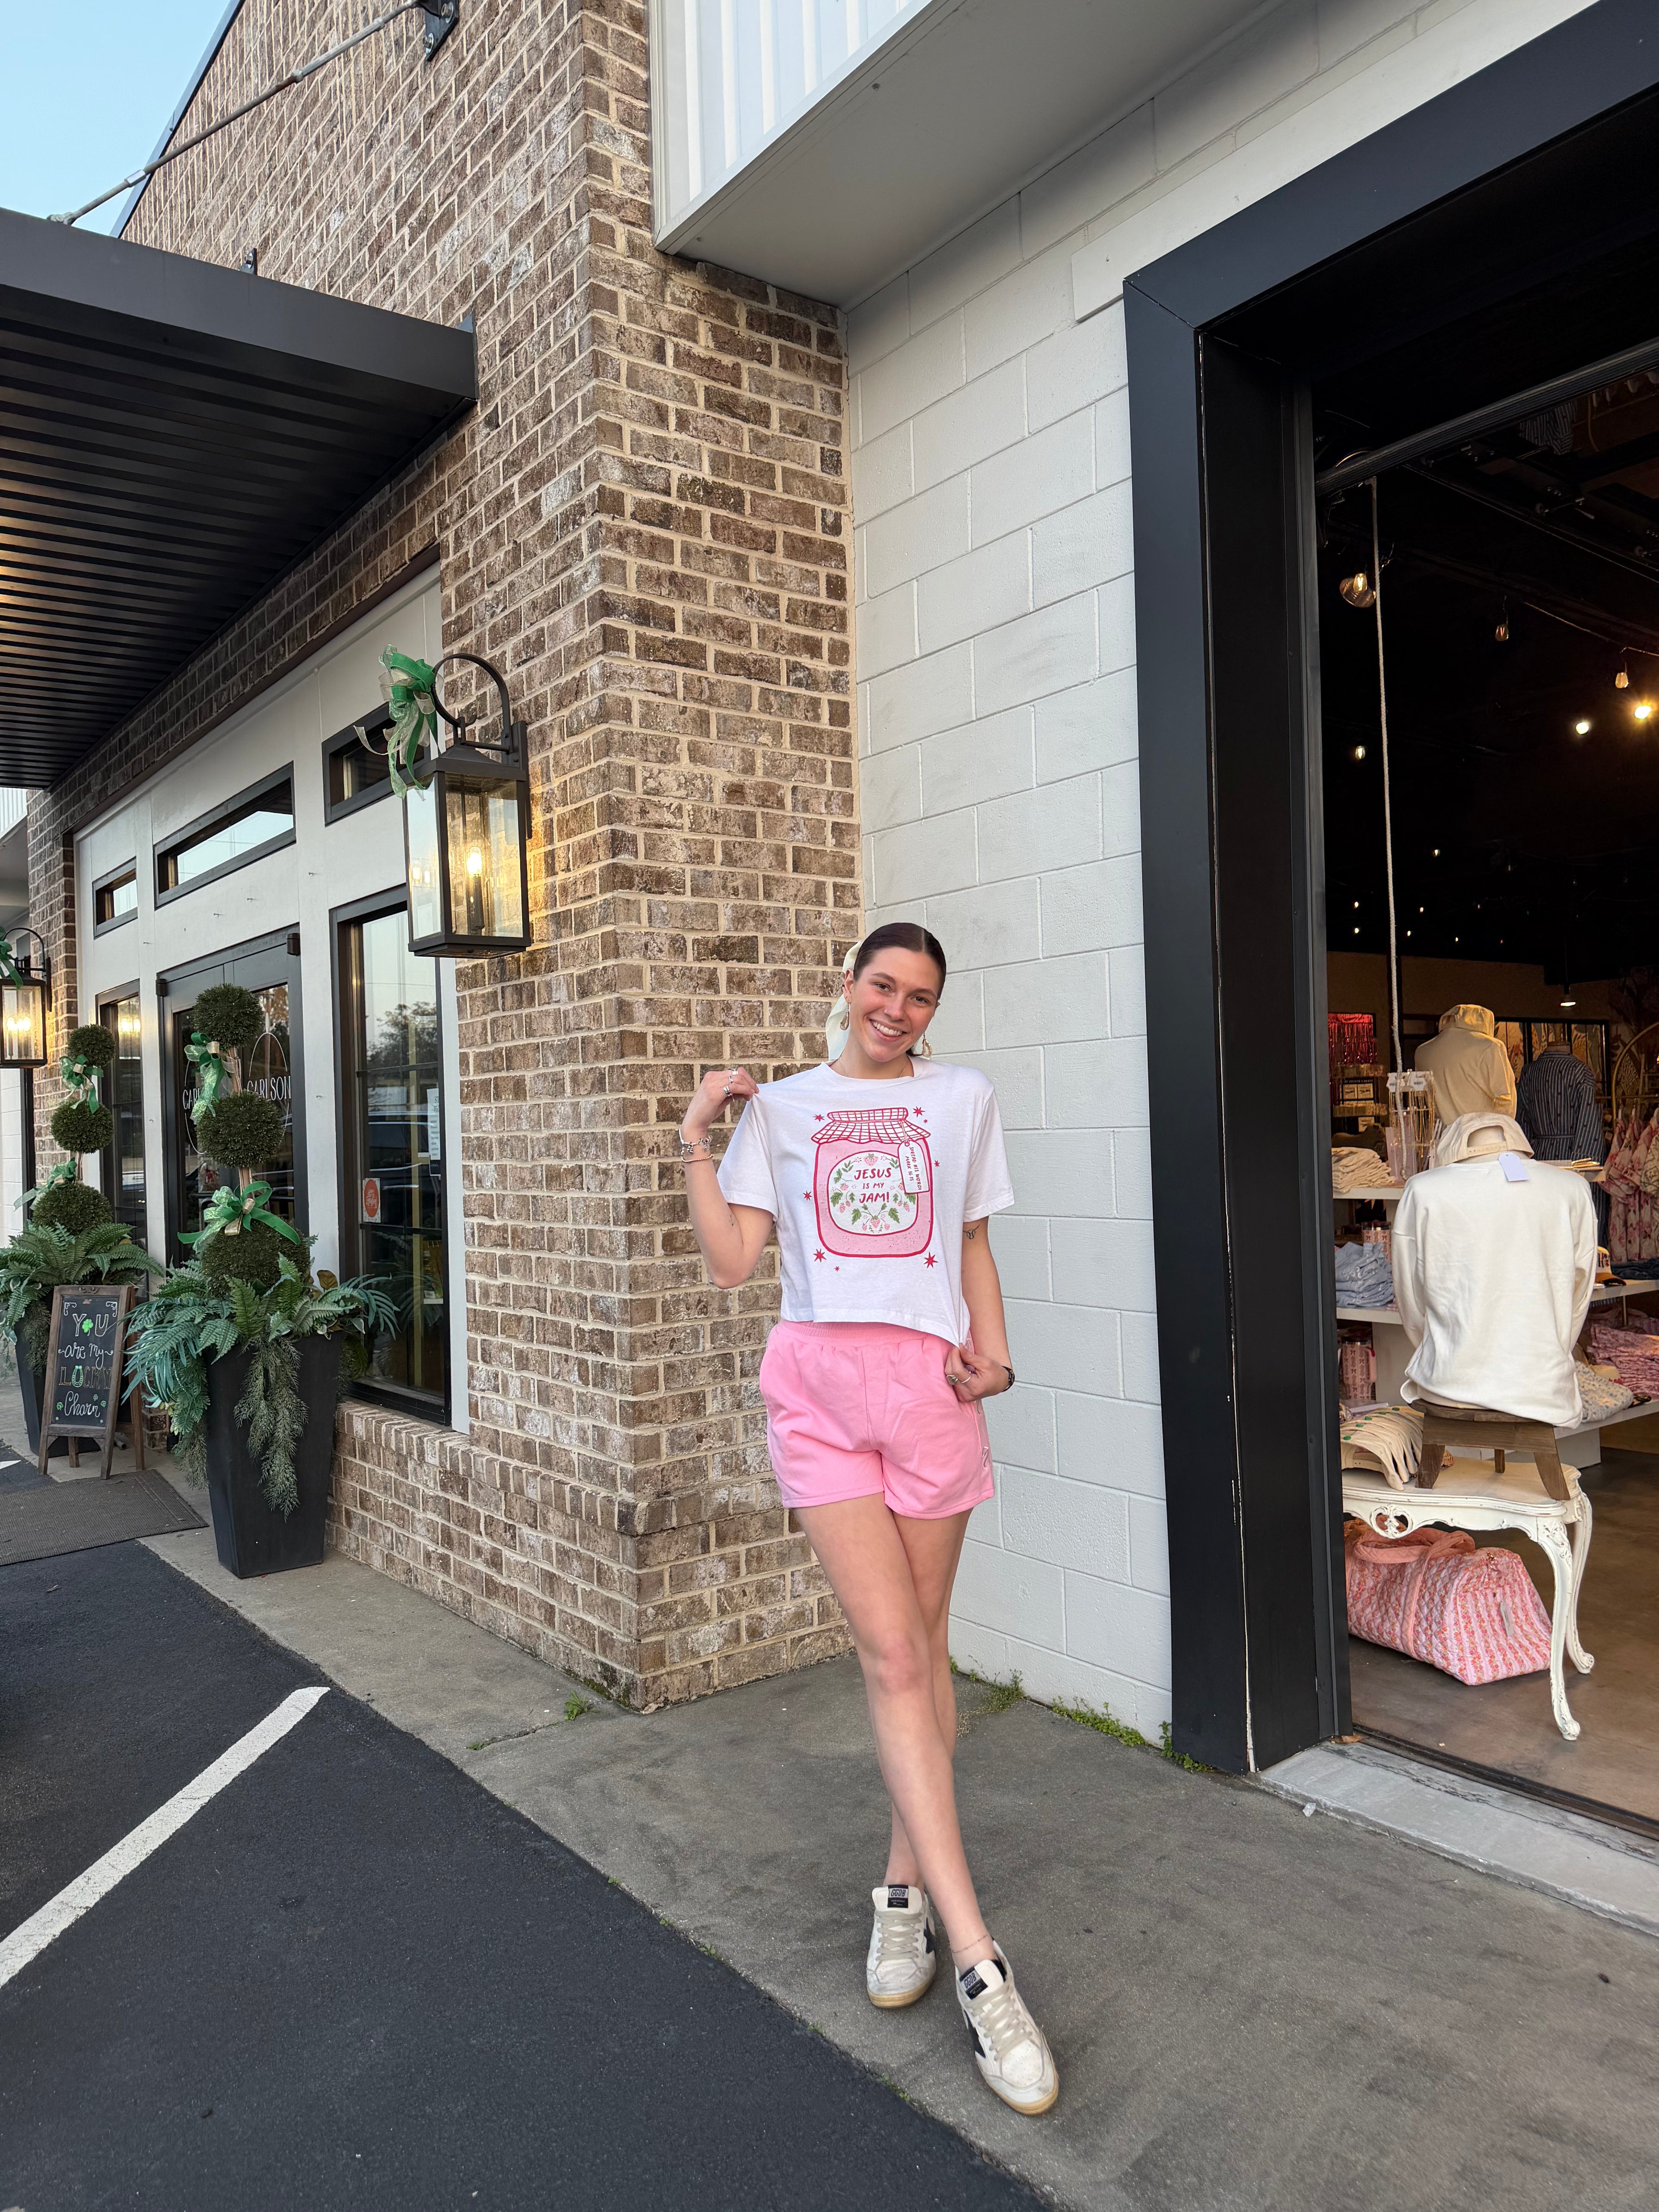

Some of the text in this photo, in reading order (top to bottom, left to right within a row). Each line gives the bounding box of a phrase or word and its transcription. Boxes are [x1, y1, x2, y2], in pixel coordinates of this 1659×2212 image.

[854, 1168, 892, 1180] JESUS
[859, 1192, 889, 1203] JAM!
[65, 1342, 86, 1359] are
[59, 1365, 113, 1390] LUCKY
[65, 1391, 100, 1418] Charm
[964, 1972, 976, 1988] GGDB
